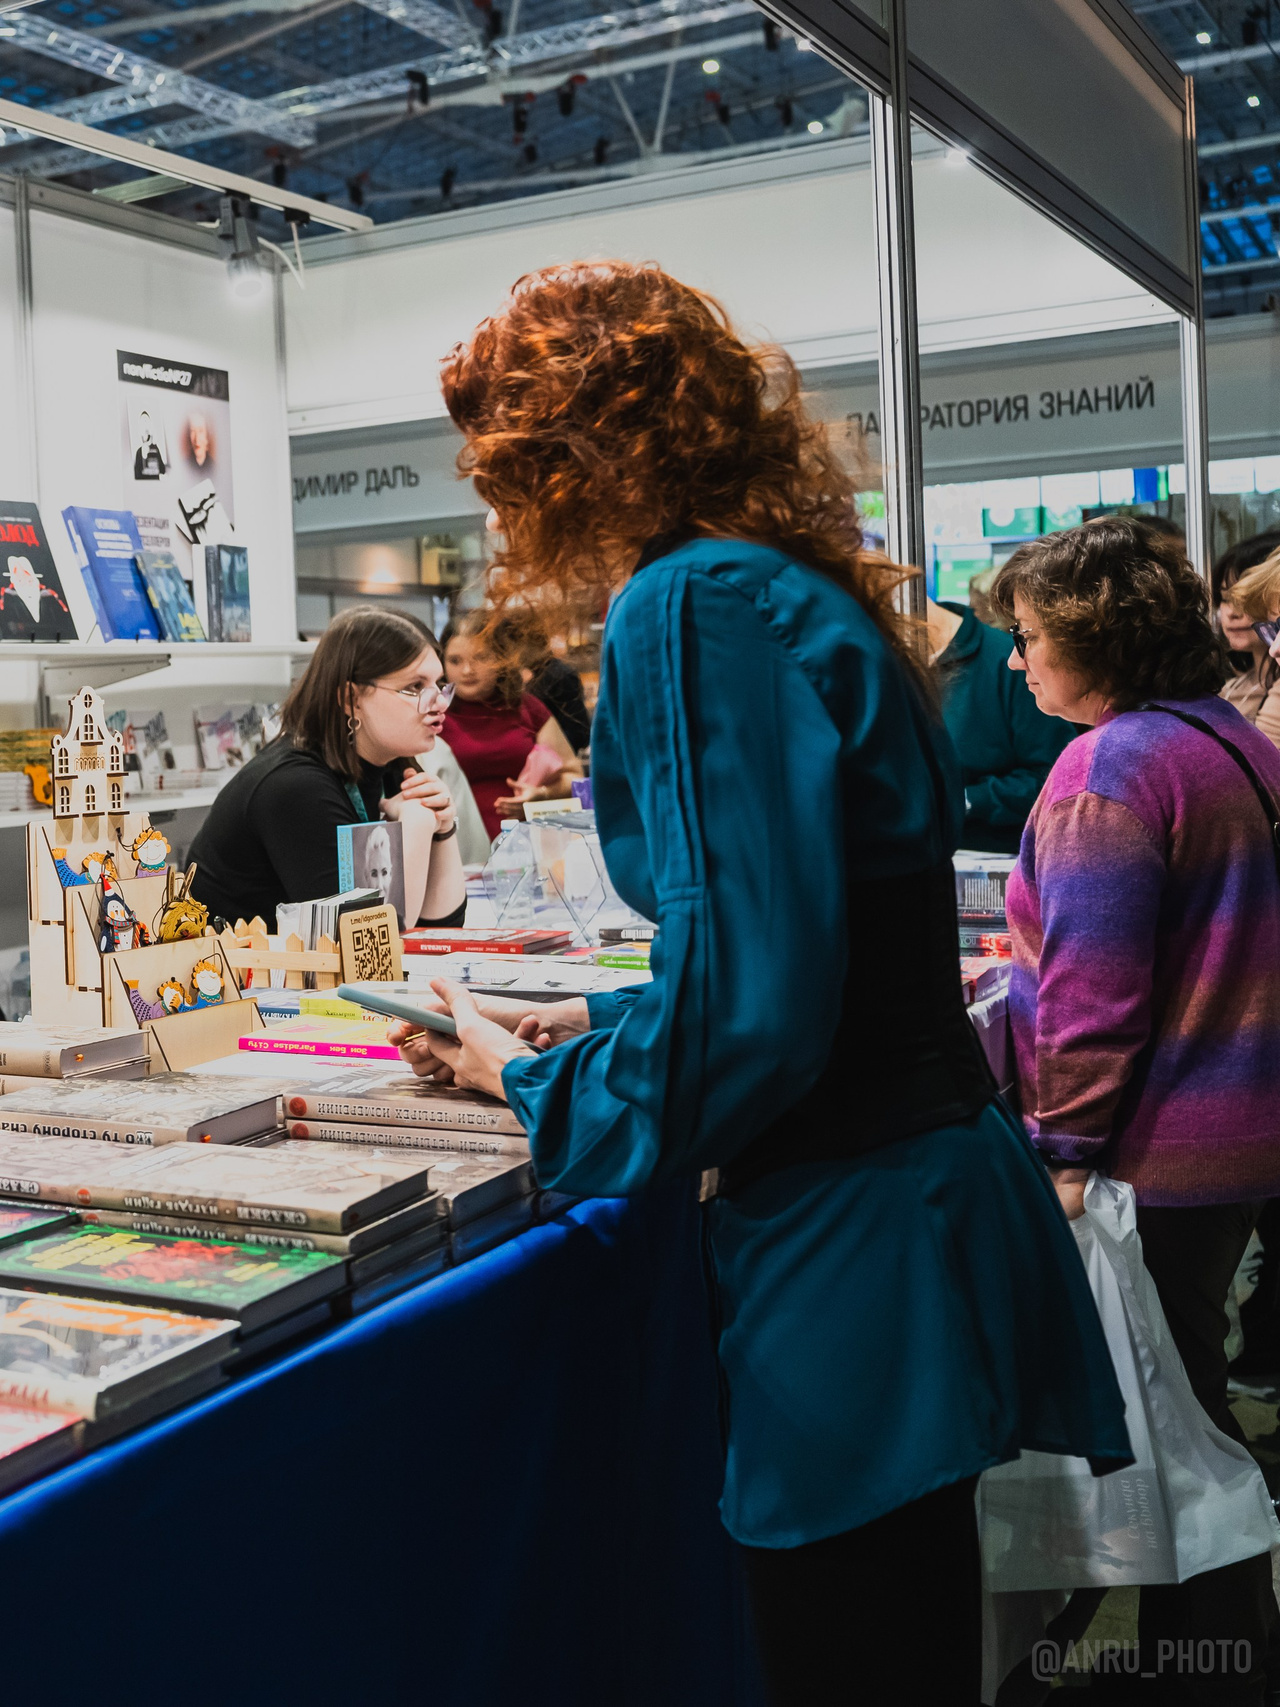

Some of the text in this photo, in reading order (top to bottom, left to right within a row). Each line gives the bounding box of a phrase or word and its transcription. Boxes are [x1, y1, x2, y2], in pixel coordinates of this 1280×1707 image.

[847, 375, 1155, 438] ЛАРАТОРИЯ ЗНАНИЙ
[365, 464, 419, 496] ДАЛЬ
[420, 943, 452, 953] Калевала
[247, 1039, 316, 1053] Paradise City
[236, 1206, 308, 1226] СКАЗКИ
